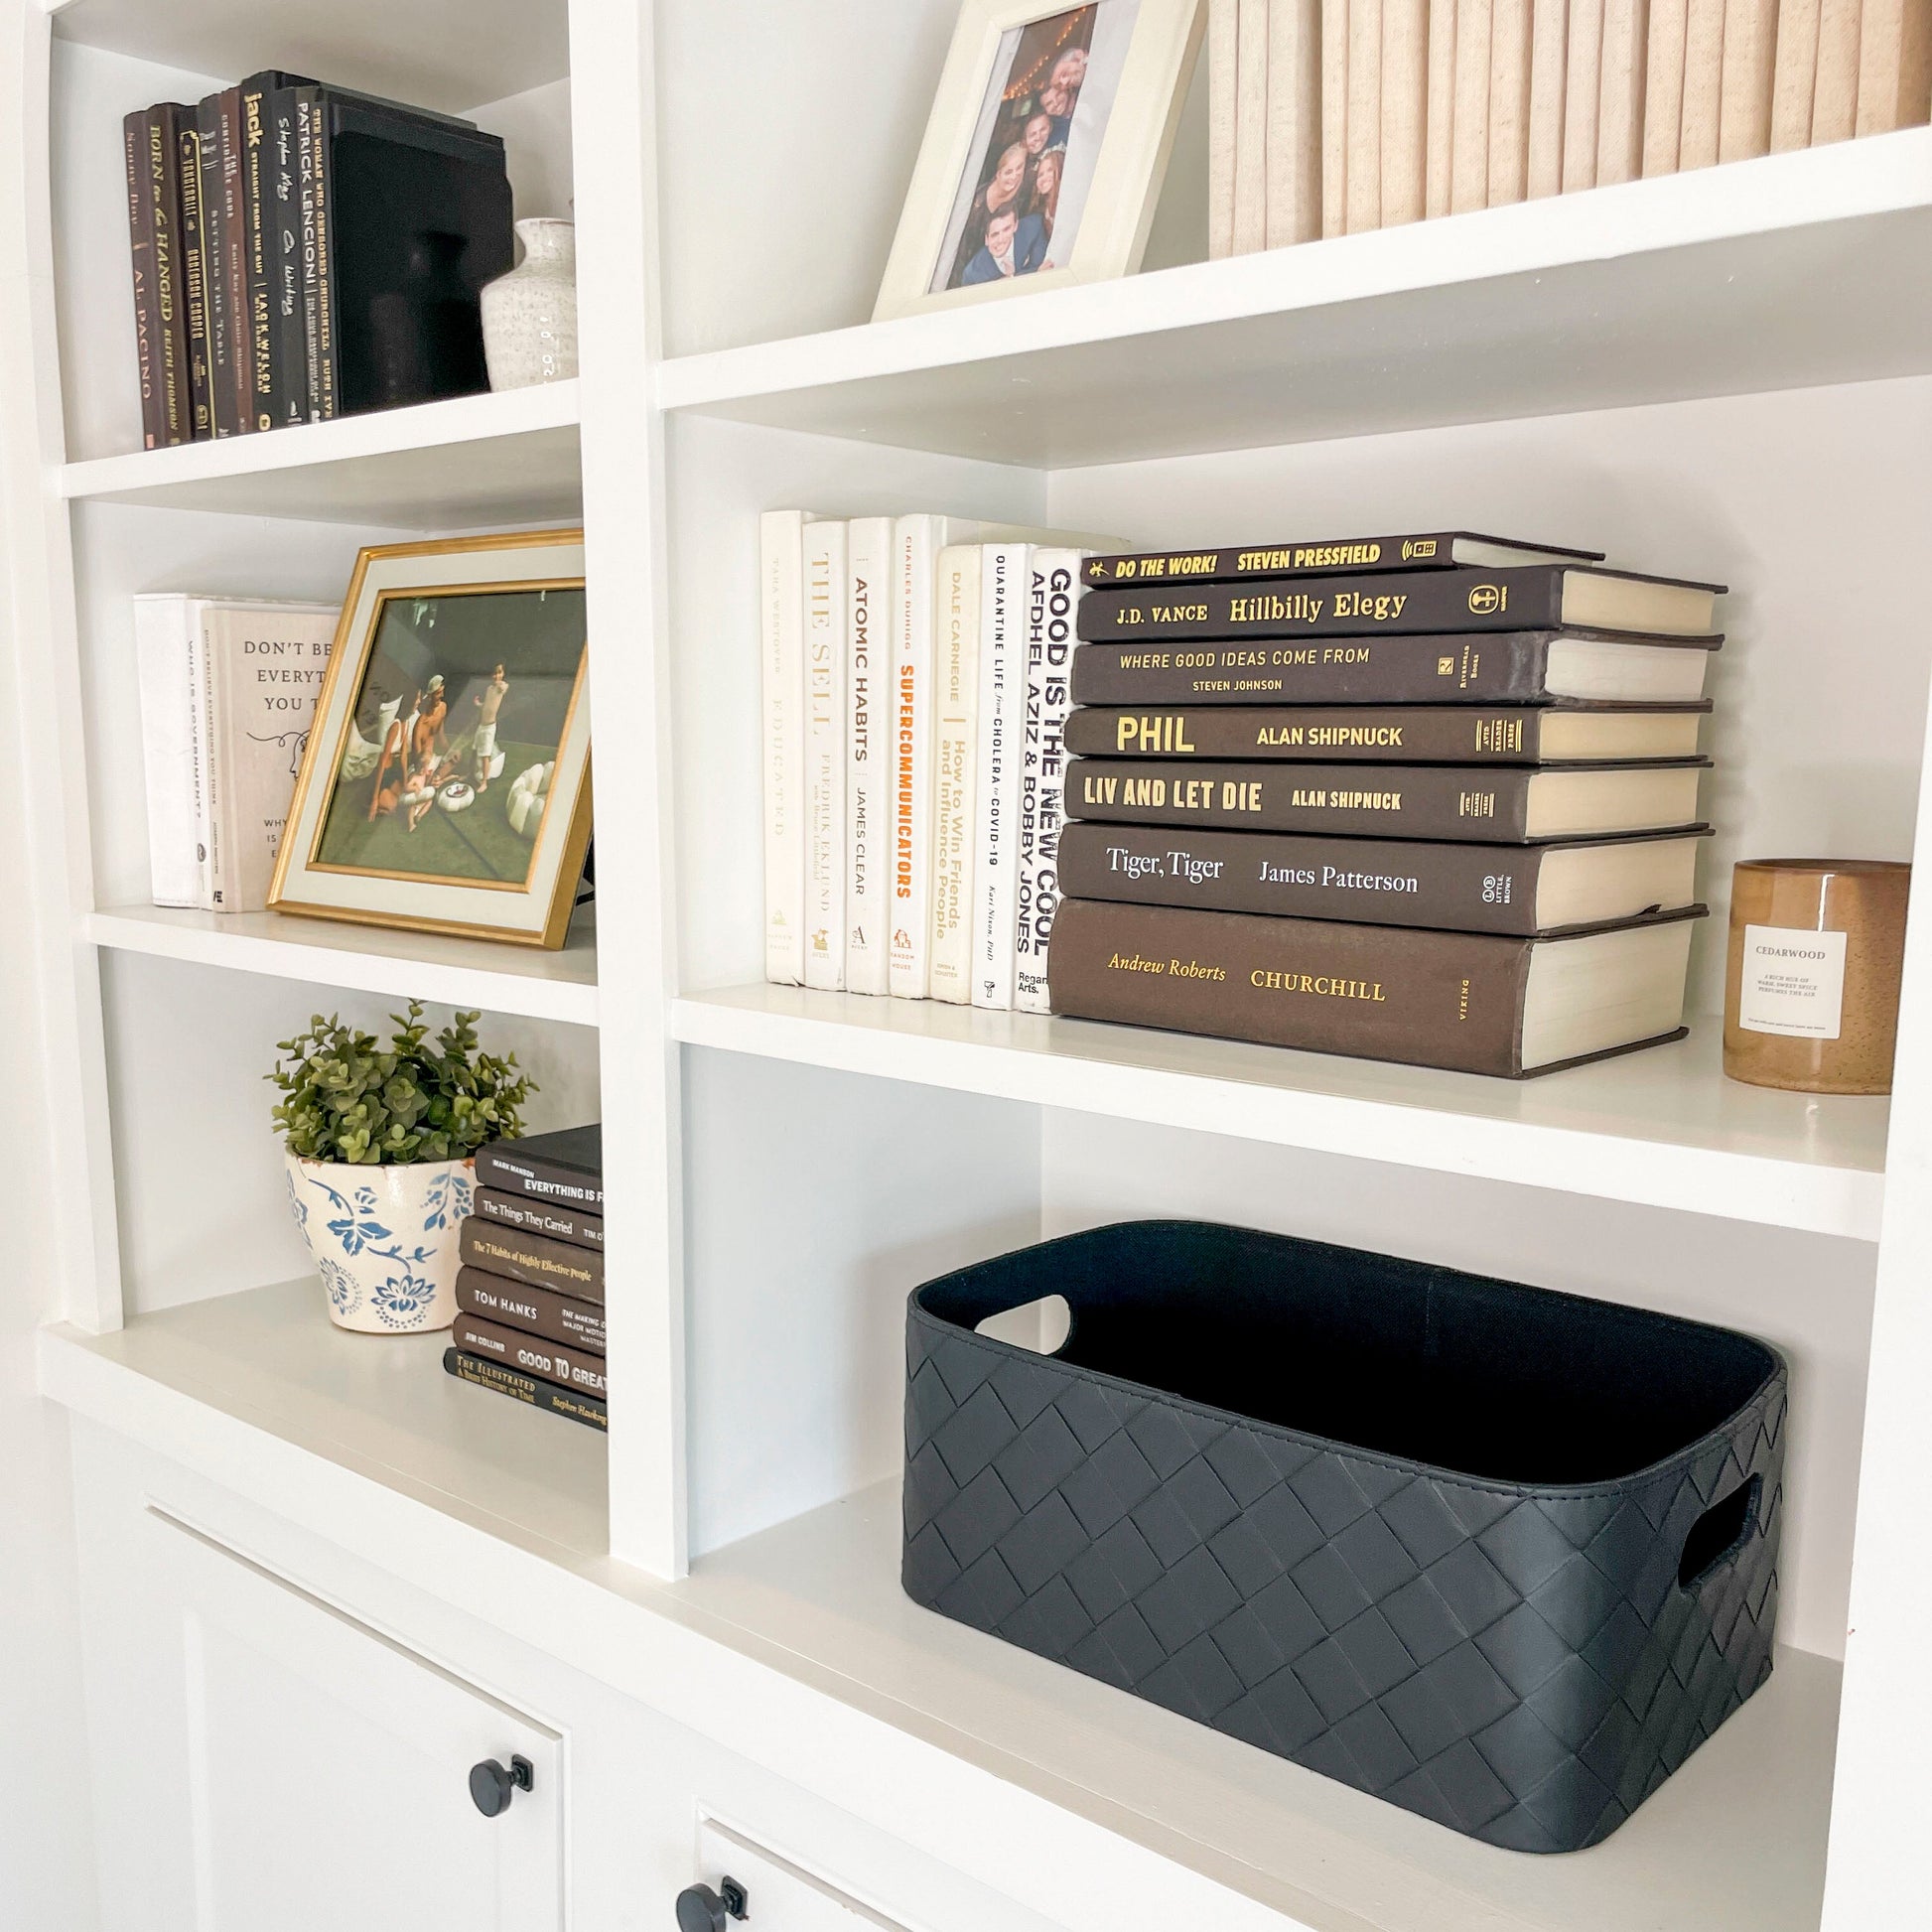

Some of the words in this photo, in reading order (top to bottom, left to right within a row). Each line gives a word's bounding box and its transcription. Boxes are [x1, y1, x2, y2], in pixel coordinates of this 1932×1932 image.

[244, 93, 265, 148] jack
[313, 108, 322, 134] THE
[150, 125, 164, 181] BORN
[298, 102, 313, 184] PATRICK
[314, 138, 324, 179] WOMAN
[182, 159, 197, 216] VANDERBILT
[251, 152, 259, 200] STRAIGHT
[316, 183, 325, 207] WHO
[253, 203, 261, 230] FROM
[282, 229, 295, 254] On
[301, 190, 316, 284] LENCIONI
[134, 270, 146, 300] AL
[156, 232, 173, 322] HANGED
[187, 249, 202, 299] ANDERSON
[281, 265, 296, 317] Writing
[190, 303, 205, 340] COOPER
[259, 293, 270, 333] JACK
[320, 279, 330, 351] CHURCHILL
[137, 310, 152, 399] PACINO
[260, 339, 272, 394] WELCH
[323, 359, 331, 391] RUTH
[167, 372, 179, 430] THOMSON
[1115, 561, 1137, 579] DO
[1139, 558, 1167, 577] THE
[1168, 555, 1218, 576] WORK!
[1237, 550, 1291, 573] STEVEN
[1293, 544, 1381, 569] PRESSFIELD
[812, 552, 830, 629] THE
[951, 572, 962, 615] DALE
[995, 555, 1006, 650] QUARANTINE
[1229, 594, 1324, 624] Hillbilly
[1332, 591, 1408, 621] Elegy
[855, 577, 868, 669] ATOMIC
[1028, 570, 1045, 676] AFDHEL
[1047, 568, 1072, 667] GOOD
[1116, 608, 1145, 625] J.D.
[1151, 605, 1209, 623] VANCE
[257, 670, 327, 684] EVERYT
[950, 620, 961, 702] CARNEGIE
[994, 659, 1004, 690] LIFE
[1119, 654, 1171, 670] WHERE
[1174, 652, 1216, 669] GOOD
[1221, 651, 1267, 668] IDEAS
[1272, 649, 1318, 666] COME
[1322, 648, 1371, 664] FROM
[190, 683, 196, 697] IS
[264, 697, 302, 710] YOU
[812, 643, 830, 735] SELL
[1045, 677, 1068, 706] IS
[1192, 680, 1231, 691] STEVEN
[1233, 680, 1283, 691] JOHNSON
[855, 677, 868, 762] HABITS
[1025, 683, 1040, 745] AZIZ
[992, 718, 1002, 784] CHOLERA
[1042, 712, 1066, 777] THE
[1116, 716, 1196, 753] PHIL
[1256, 727, 1304, 746] ALAN
[1308, 727, 1403, 747] SHIPNUCK
[192, 704, 202, 819] GOVERNMENT?
[772, 699, 785, 836] EDUCATED
[941, 740, 951, 774] and
[954, 740, 966, 783] How
[1024, 751, 1037, 767] &
[821, 755, 831, 832] FREDRIK
[897, 665, 914, 899] SUPERCOMMUNICATORS
[953, 788, 964, 809] to
[1084, 777, 1118, 805] LIV
[1123, 779, 1167, 807] AND
[1173, 780, 1215, 809] LET
[1222, 782, 1263, 812] DIE
[1291, 790, 1327, 808] ALAN
[1330, 791, 1402, 811] SHIPNUCK
[856, 787, 866, 839] JAMES
[937, 775, 952, 869] Influence
[989, 799, 1000, 866] COVID-19
[1021, 776, 1036, 866] BOBBY
[1038, 788, 1063, 862] NEW
[952, 816, 964, 854] Win
[821, 841, 831, 912] EKLUND
[855, 843, 866, 896] CLEAR
[1106, 847, 1165, 880] Tiger,
[1167, 851, 1224, 884] Tiger
[1259, 861, 1316, 885] James
[1321, 866, 1419, 894] Patterson
[936, 875, 948, 940] People
[949, 860, 962, 930] Friends
[1496, 874, 1505, 903] LITTLE,
[1017, 871, 1033, 954] JONES
[1034, 869, 1058, 957] COOL
[1108, 952, 1166, 975] Andrew
[1168, 959, 1227, 982] Roberts
[1756, 946, 1826, 960] CEDARWOOD
[1018, 982, 1039, 994] Arts.
[1019, 971, 1047, 985] Regan
[1250, 969, 1386, 1003] CHURCHILL
[1459, 978, 1470, 1021] VIKING
[492, 1159, 510, 1171] MARK
[510, 1165, 535, 1179] MANSON
[524, 1178, 584, 1199] EVERYTHING
[584, 1189, 596, 1201] IS
[483, 1200, 498, 1214] The
[498, 1202, 524, 1224] Things
[525, 1210, 544, 1230] They
[544, 1216, 573, 1236] Carried
[583, 1229, 597, 1240] TIM
[473, 1241, 486, 1254] The
[485, 1242, 491, 1255] 7
[491, 1243, 511, 1260] Habits
[511, 1250, 519, 1262] of
[519, 1253, 541, 1270] Highly
[541, 1258, 570, 1277] Effective
[570, 1267, 592, 1282] People
[474, 1290, 497, 1308] TOM
[501, 1298, 538, 1320] HANKS
[562, 1309, 574, 1319] THE
[574, 1313, 600, 1327] MAKING
[465, 1332, 477, 1343] JIM
[478, 1338, 506, 1353] COLLINS
[562, 1320, 584, 1332] MAJOR
[455, 1355, 474, 1371] THE
[477, 1362, 536, 1391] ILLUSTRATED
[517, 1348, 552, 1372] GOOD
[555, 1357, 569, 1379] TO
[552, 1396, 577, 1413] Stephen
